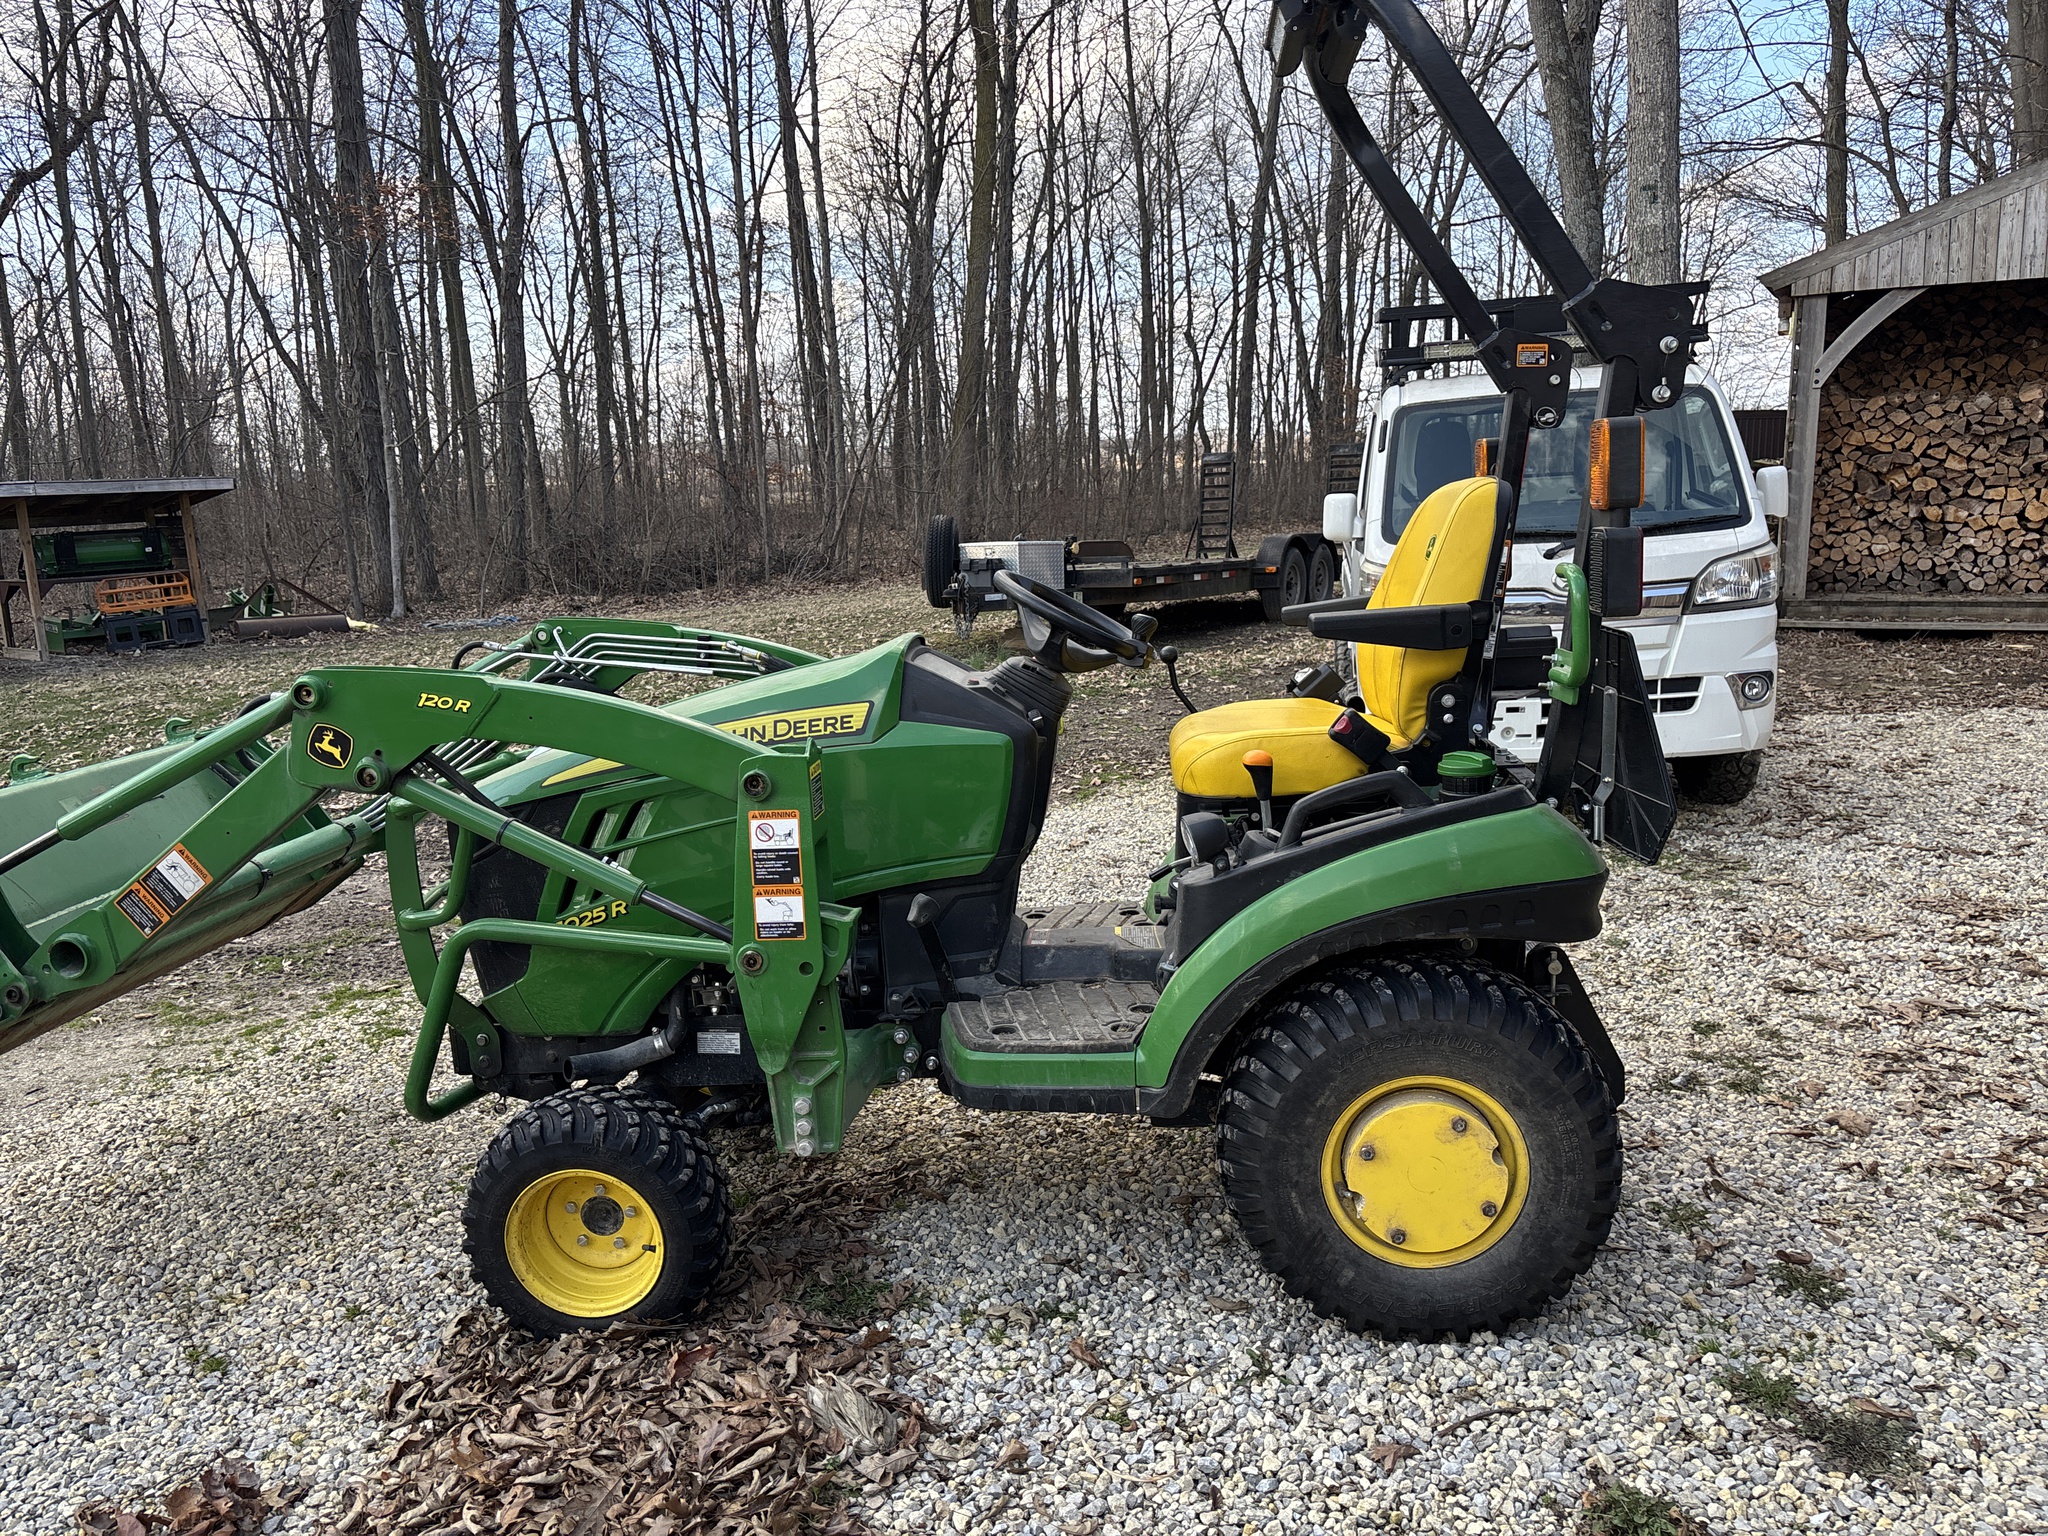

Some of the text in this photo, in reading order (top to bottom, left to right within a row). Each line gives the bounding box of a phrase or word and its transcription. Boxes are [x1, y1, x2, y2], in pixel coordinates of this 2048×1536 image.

[417, 692, 472, 714] 120 R
[773, 714, 854, 741] DEERE
[758, 811, 797, 819] WARNING
[184, 853, 208, 879] WARNING
[763, 888, 801, 896] WARNING
[141, 894, 165, 919] WARNING
[556, 900, 627, 927] 025 R
[1331, 1032, 1423, 1073] VERSA
[1430, 1032, 1499, 1059] TURF
